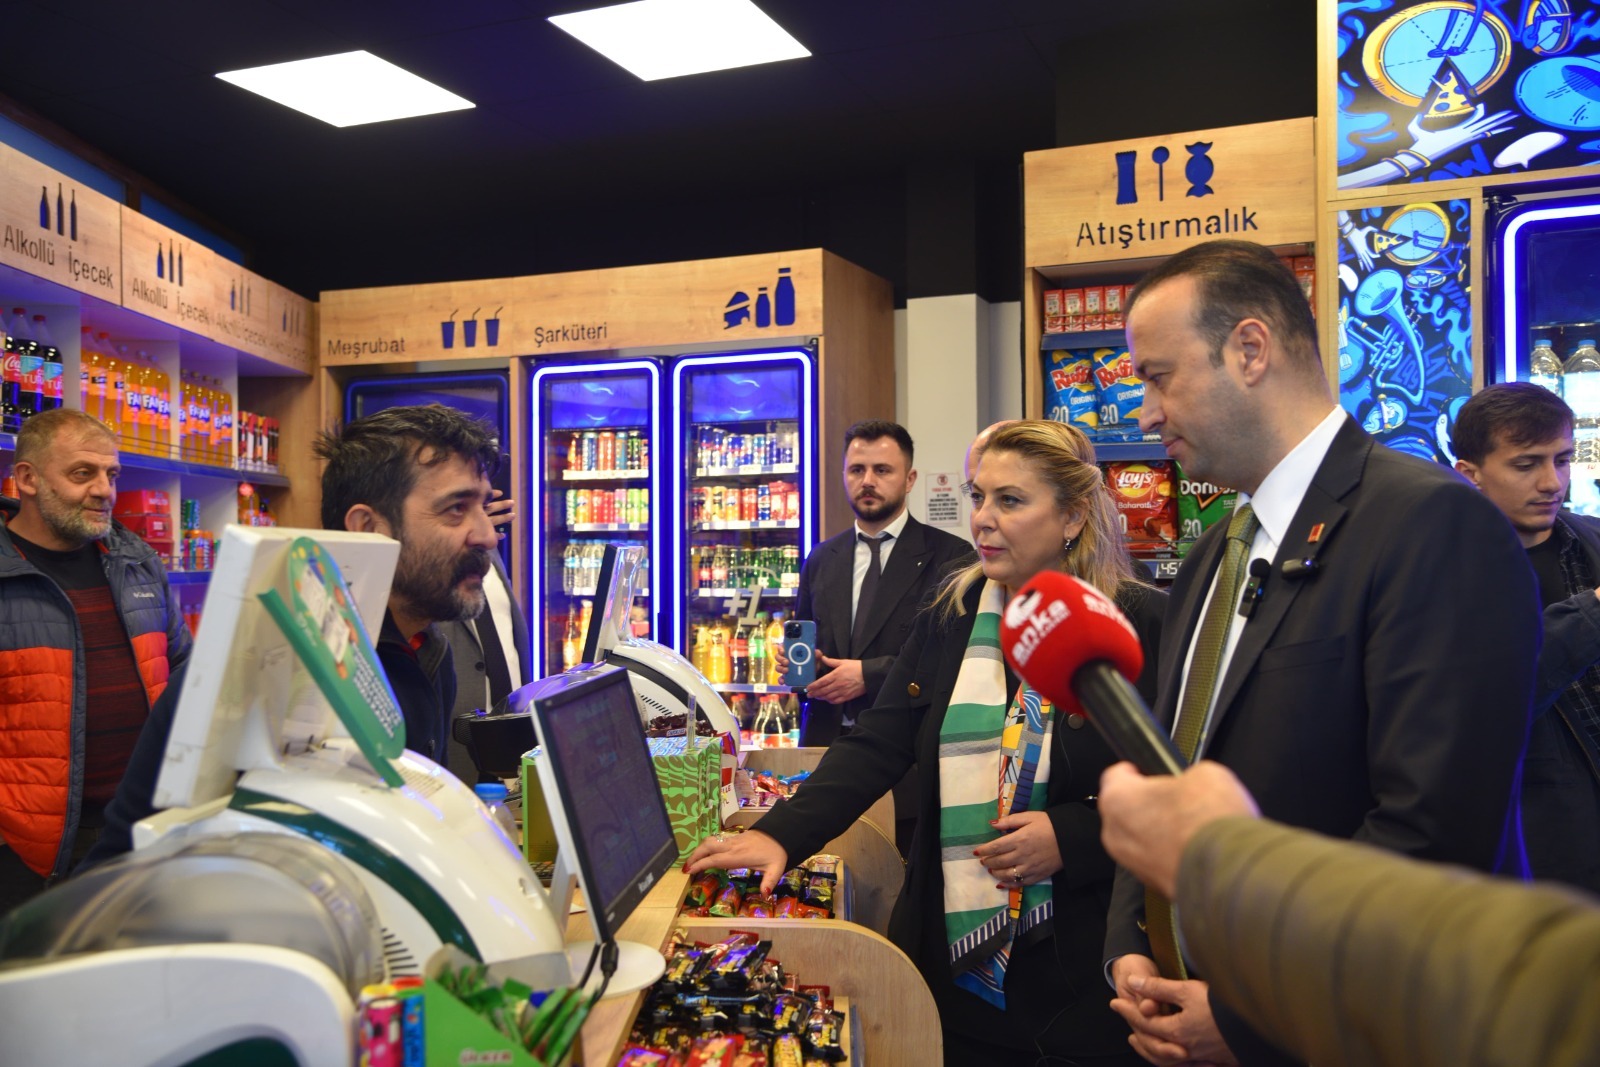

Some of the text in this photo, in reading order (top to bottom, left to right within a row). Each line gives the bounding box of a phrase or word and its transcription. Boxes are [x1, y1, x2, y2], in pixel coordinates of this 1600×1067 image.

[1076, 206, 1259, 249] Atıştırmalık
[3, 224, 115, 290] Alkollü İçecek
[131, 277, 169, 310] Alkollü
[533, 321, 608, 349] Şarküteri
[327, 336, 406, 359] Meşrubat
[1070, 395, 1097, 405] ORIGINA
[1117, 387, 1145, 401] ORIGINA
[1052, 405, 1070, 423] 20
[1101, 404, 1119, 425] 20
[1117, 471, 1154, 489] Lay's
[1183, 518, 1202, 539] 20
[1012, 599, 1070, 662] anka
